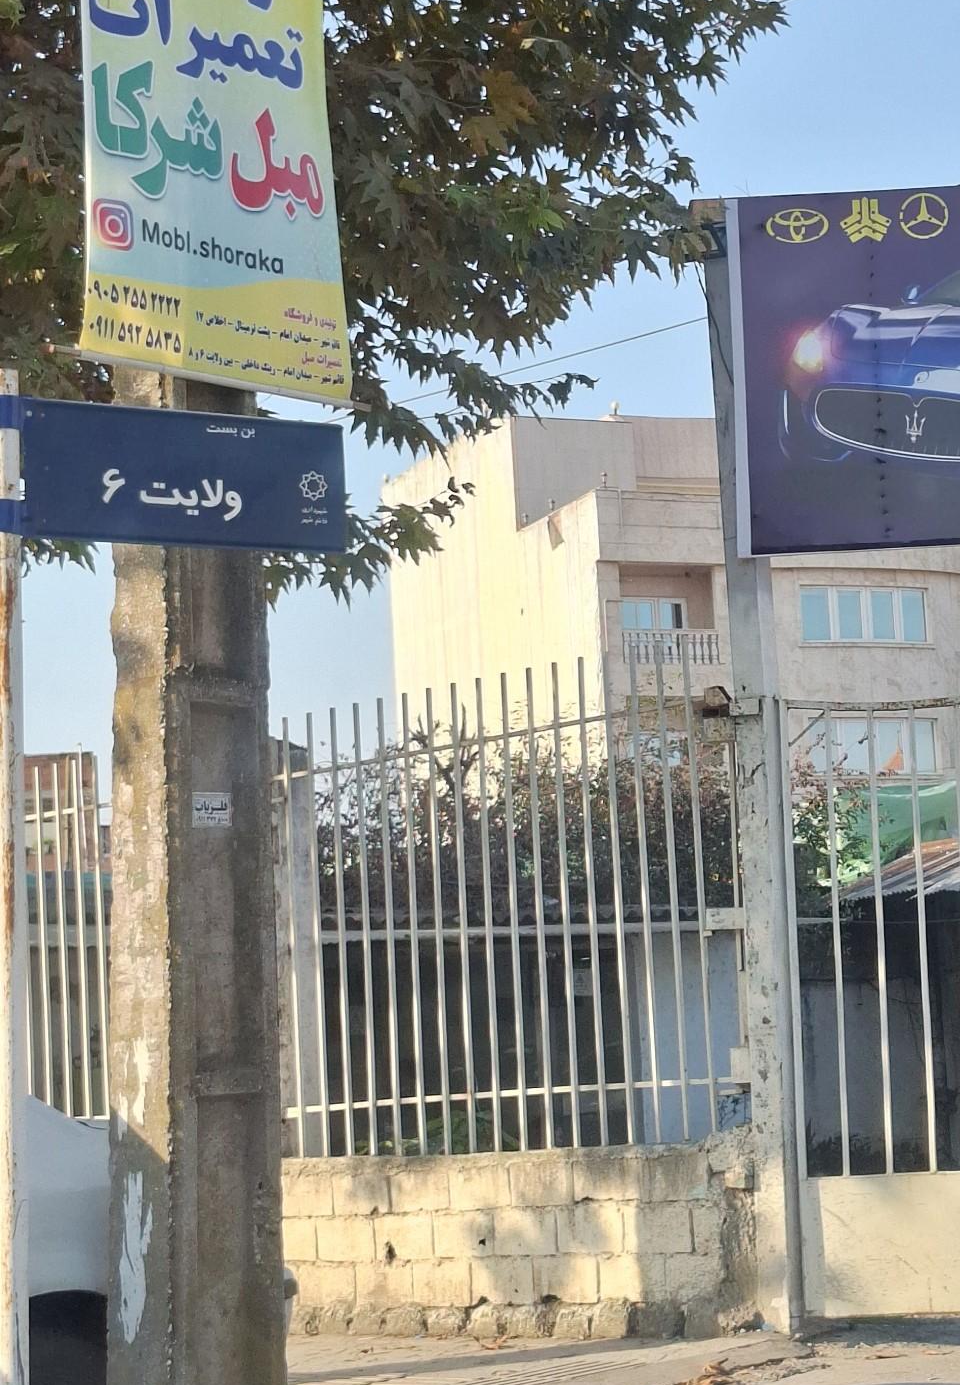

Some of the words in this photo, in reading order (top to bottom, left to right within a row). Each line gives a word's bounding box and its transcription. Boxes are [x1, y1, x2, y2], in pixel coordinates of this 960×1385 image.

[91, 60, 223, 198] شرکا
[231, 108, 325, 220] مبل
[141, 218, 284, 275] Mobl.shoraka
[205, 425, 238, 438] بست
[240, 426, 256, 439] بن
[101, 468, 126, 504] ۶
[139, 478, 243, 521] ولایت
